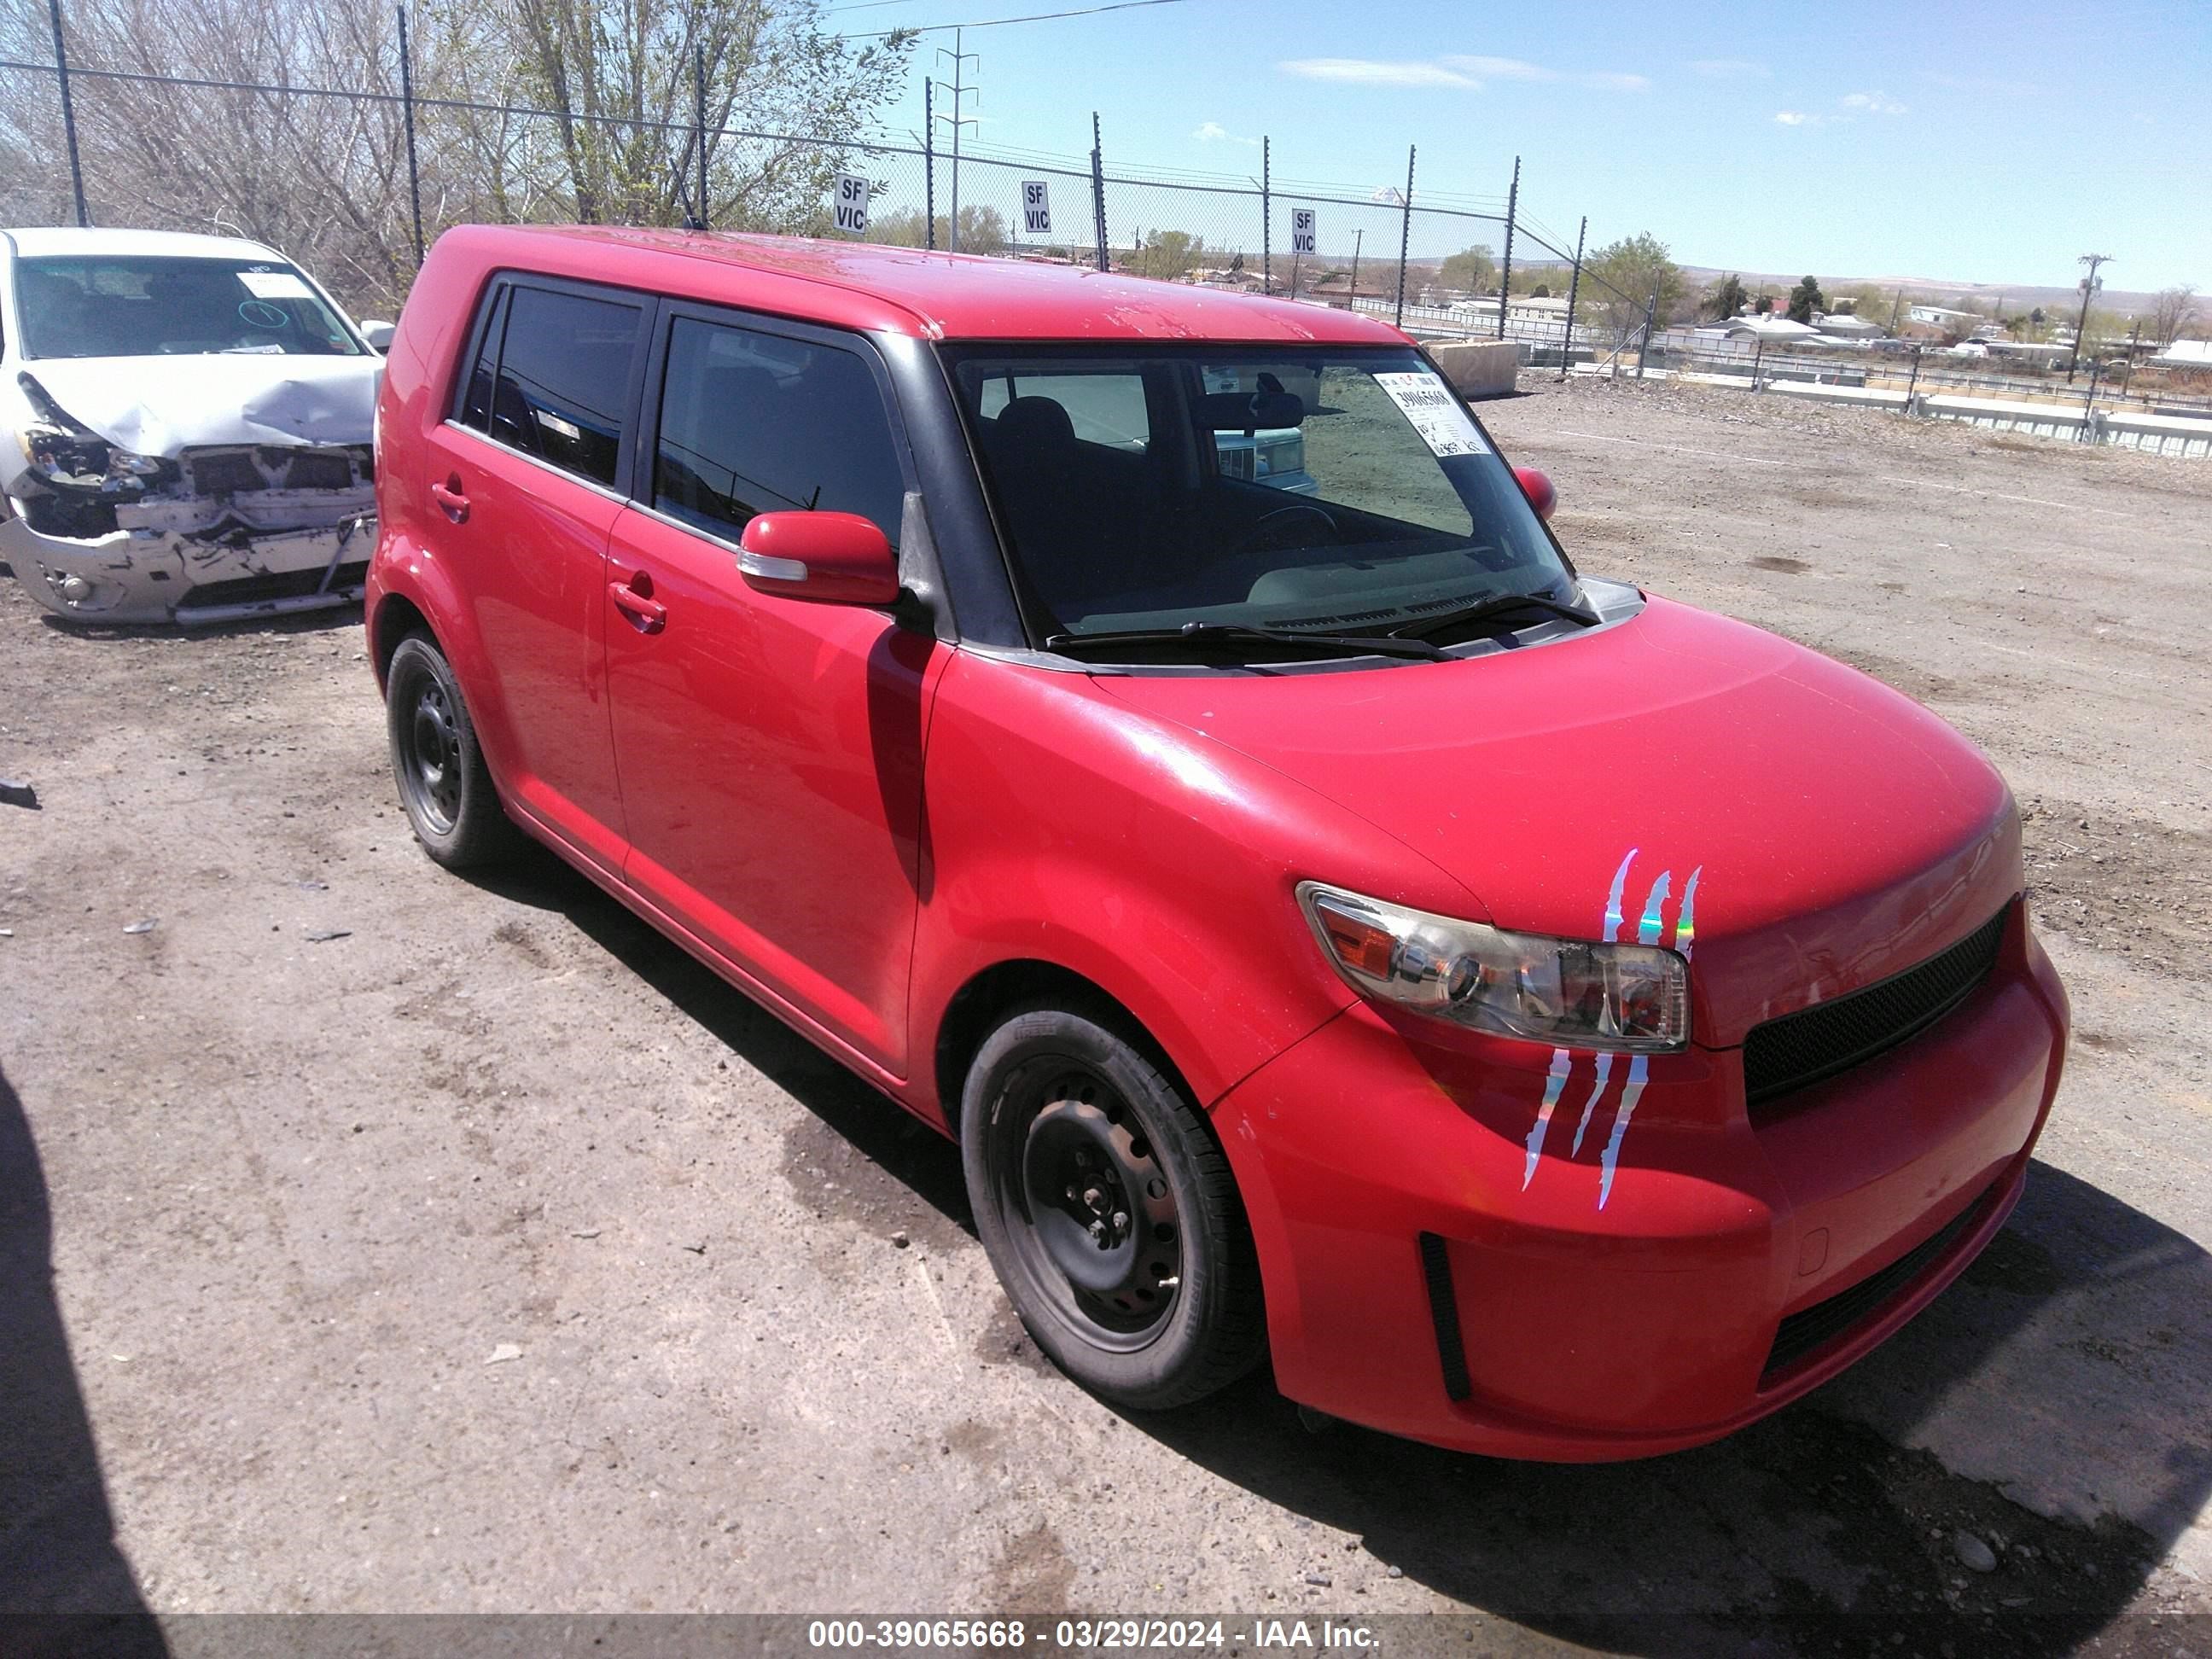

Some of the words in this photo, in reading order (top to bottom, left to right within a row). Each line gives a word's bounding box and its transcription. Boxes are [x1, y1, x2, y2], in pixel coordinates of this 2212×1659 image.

[842, 178, 863, 201] SF
[1027, 185, 1043, 204] SF
[836, 205, 864, 230] VIC
[1026, 210, 1049, 229] VIC
[1296, 212, 1311, 230] SF
[1294, 234, 1314, 252] VIC
[1396, 390, 1451, 408] 39065668
